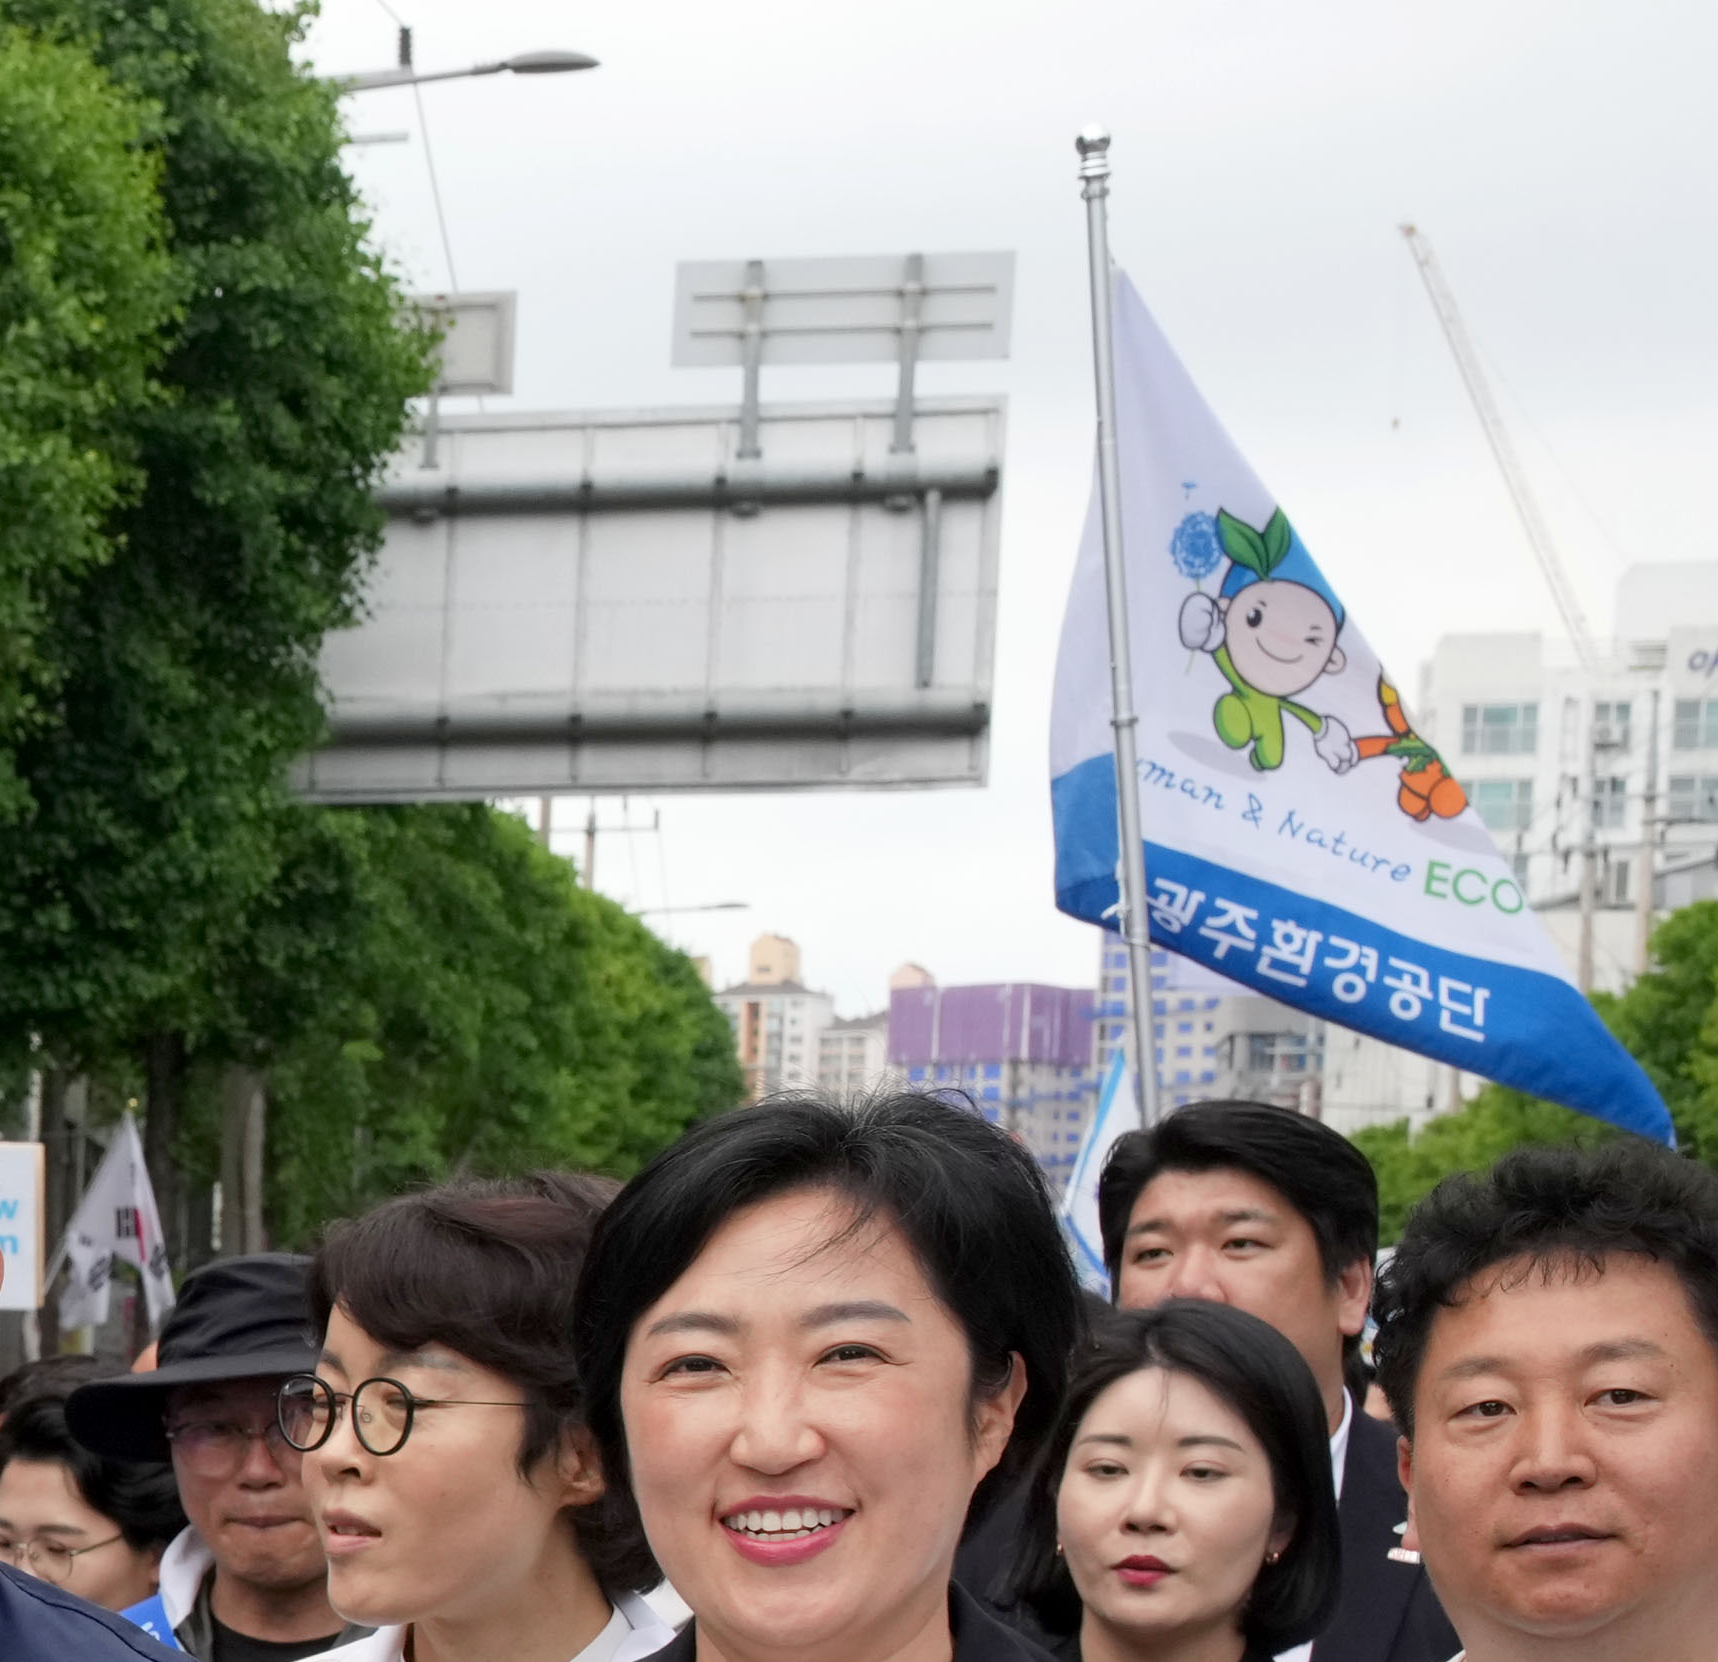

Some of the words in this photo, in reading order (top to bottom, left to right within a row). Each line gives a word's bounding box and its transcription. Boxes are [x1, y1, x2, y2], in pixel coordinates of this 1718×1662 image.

[1137, 757, 1225, 811] man
[1240, 792, 1266, 828] &
[1277, 809, 1413, 883] Nature
[1423, 858, 1526, 916] ECO
[1147, 876, 1492, 1044] 광주환경공단
